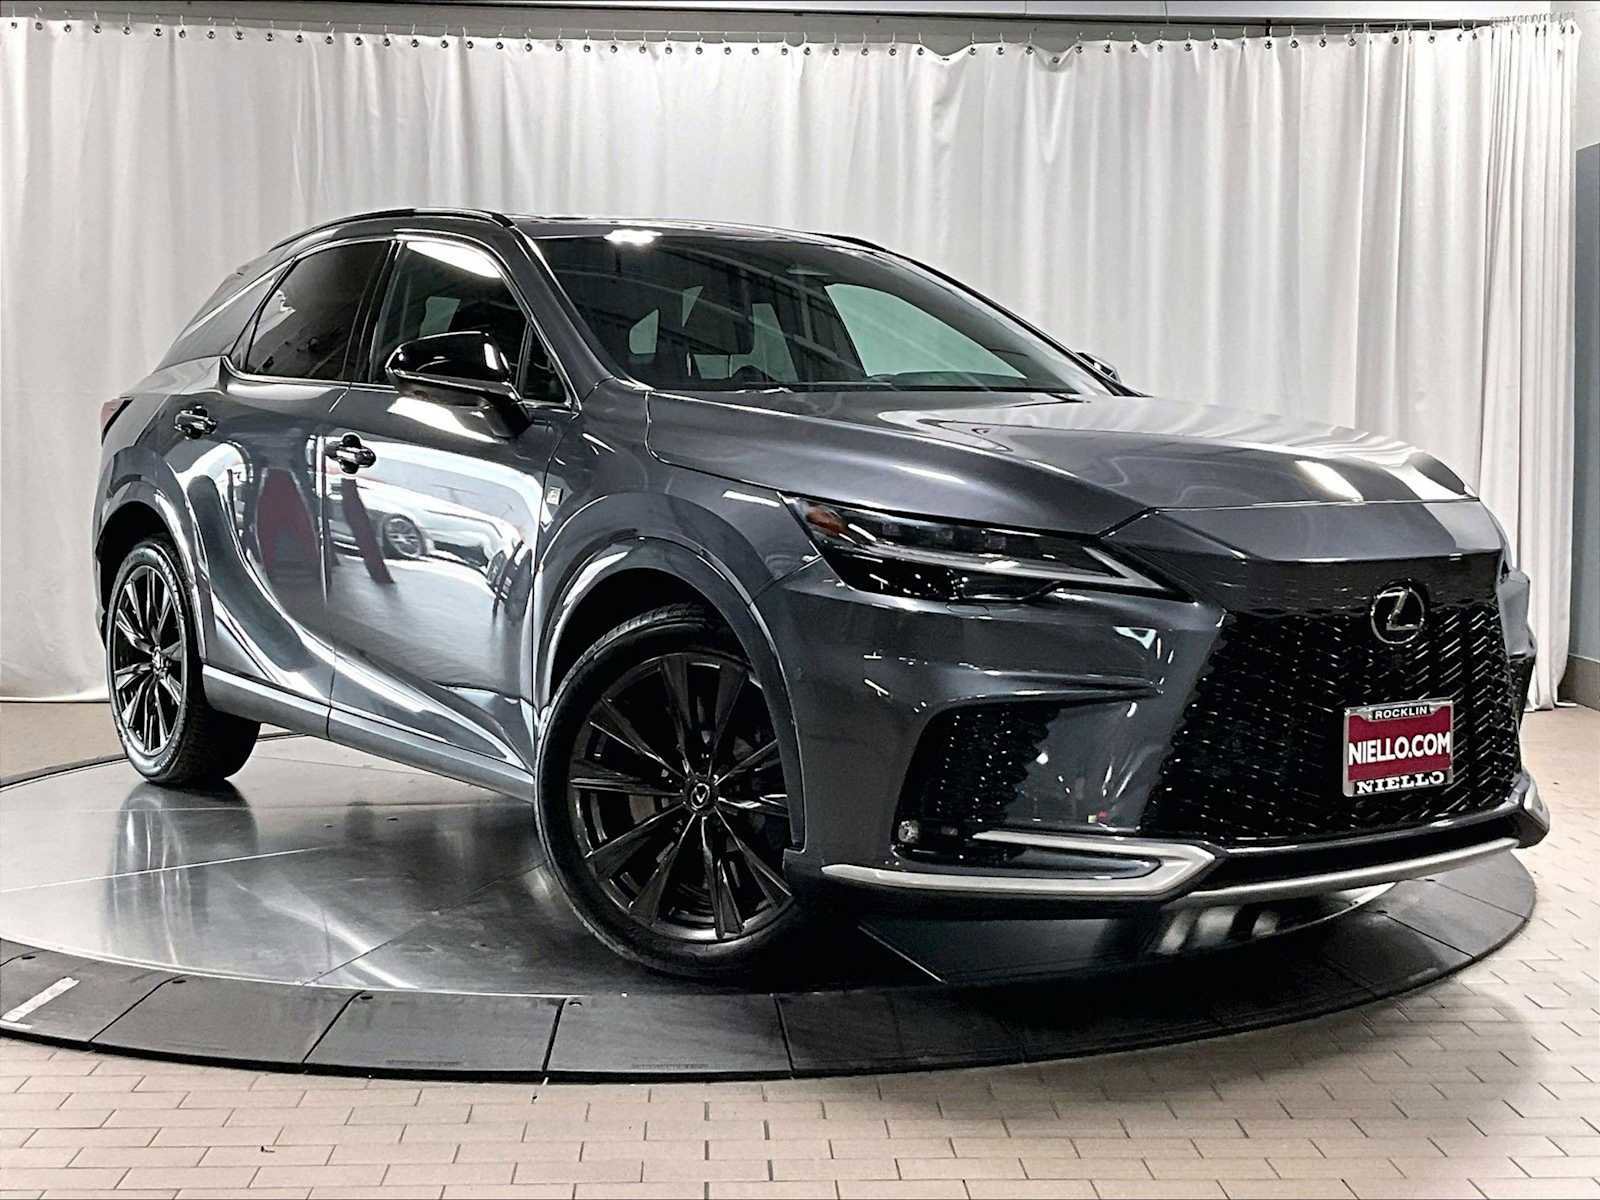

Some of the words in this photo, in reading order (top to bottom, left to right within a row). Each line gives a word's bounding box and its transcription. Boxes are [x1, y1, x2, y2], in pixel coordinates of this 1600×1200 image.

[1375, 706, 1428, 720] ROCKLIN
[1348, 731, 1451, 767] NIELLO.COM
[1356, 771, 1445, 794] NIELLO
